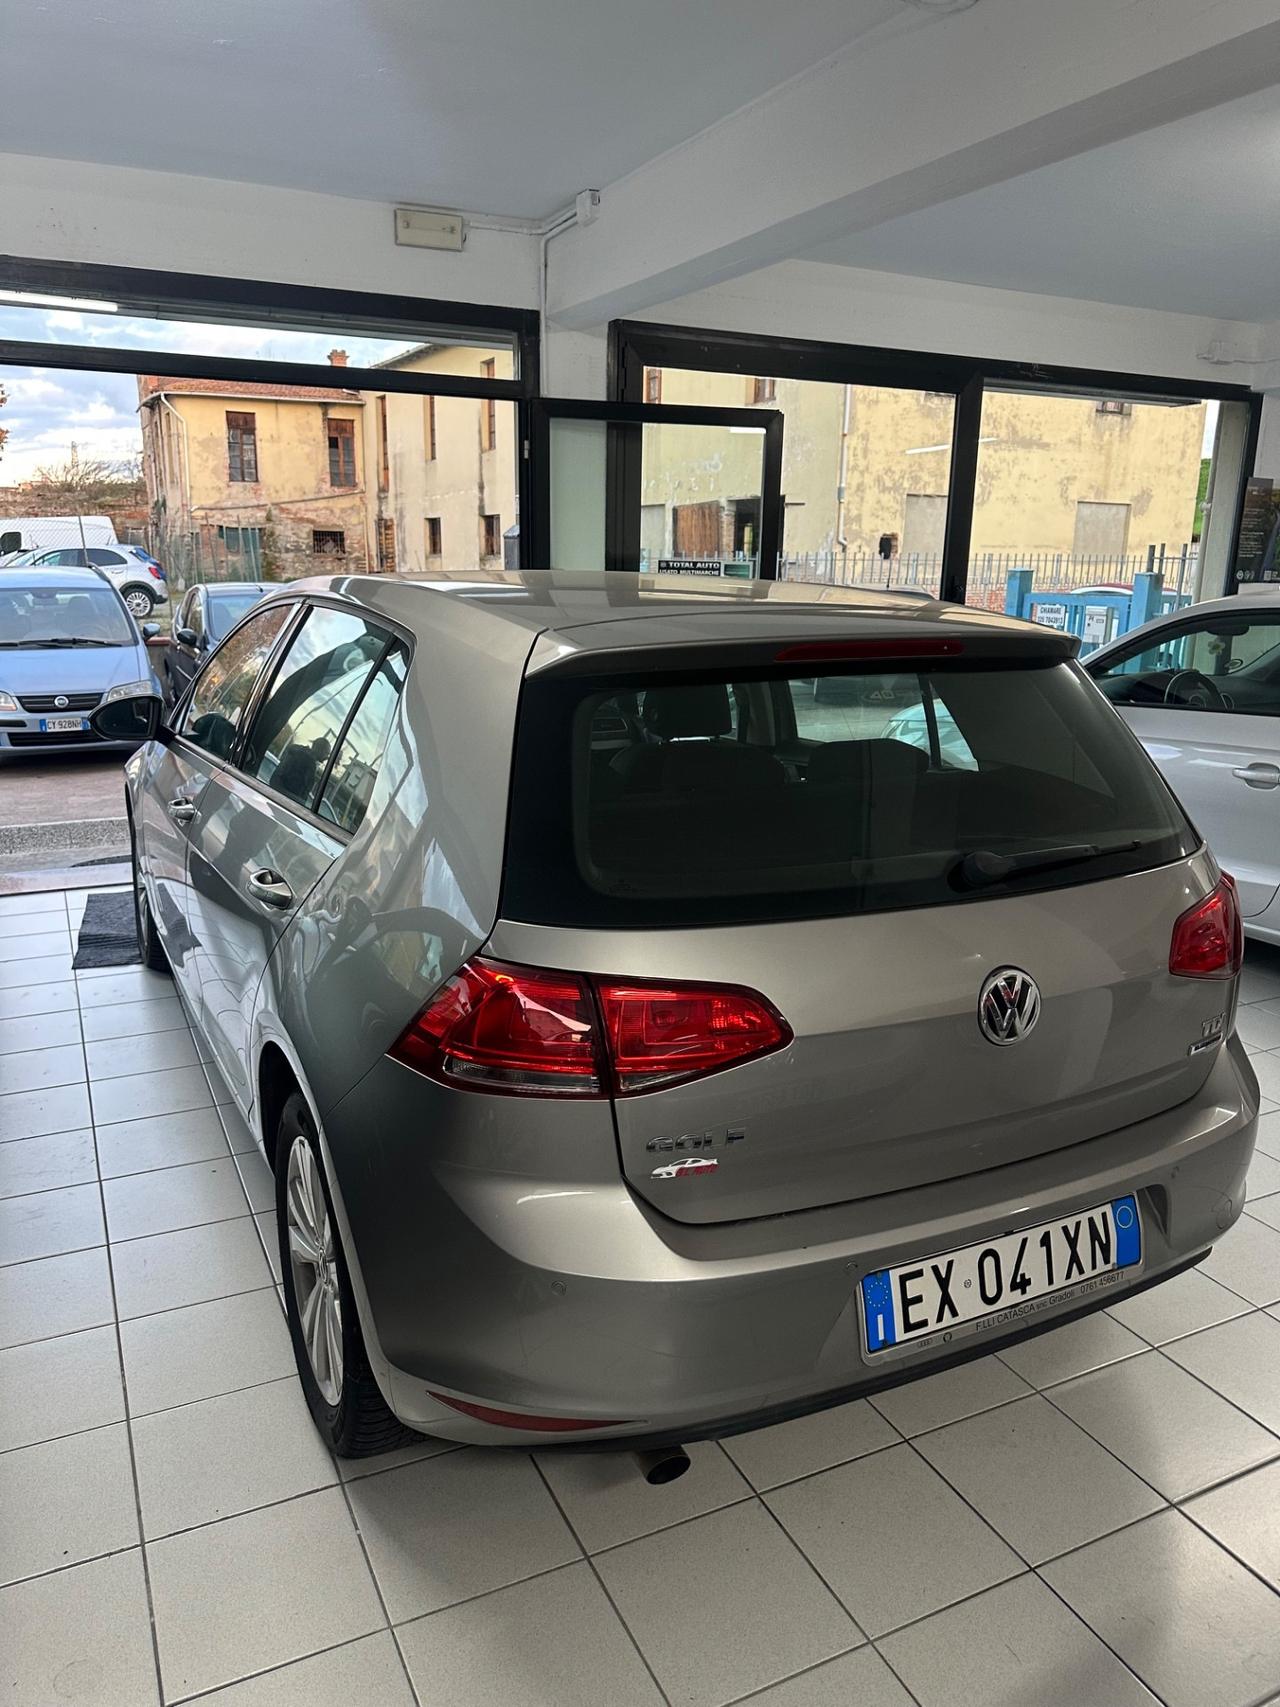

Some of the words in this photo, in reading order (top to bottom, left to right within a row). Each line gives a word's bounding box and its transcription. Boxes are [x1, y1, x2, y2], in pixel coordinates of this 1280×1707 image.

[645, 1127, 746, 1152] GOLF
[898, 1258, 960, 1334] EX
[977, 1211, 1112, 1306] 041XN
[997, 1302, 1037, 1324] CATASCA
[1048, 1288, 1075, 1305] Gradoli
